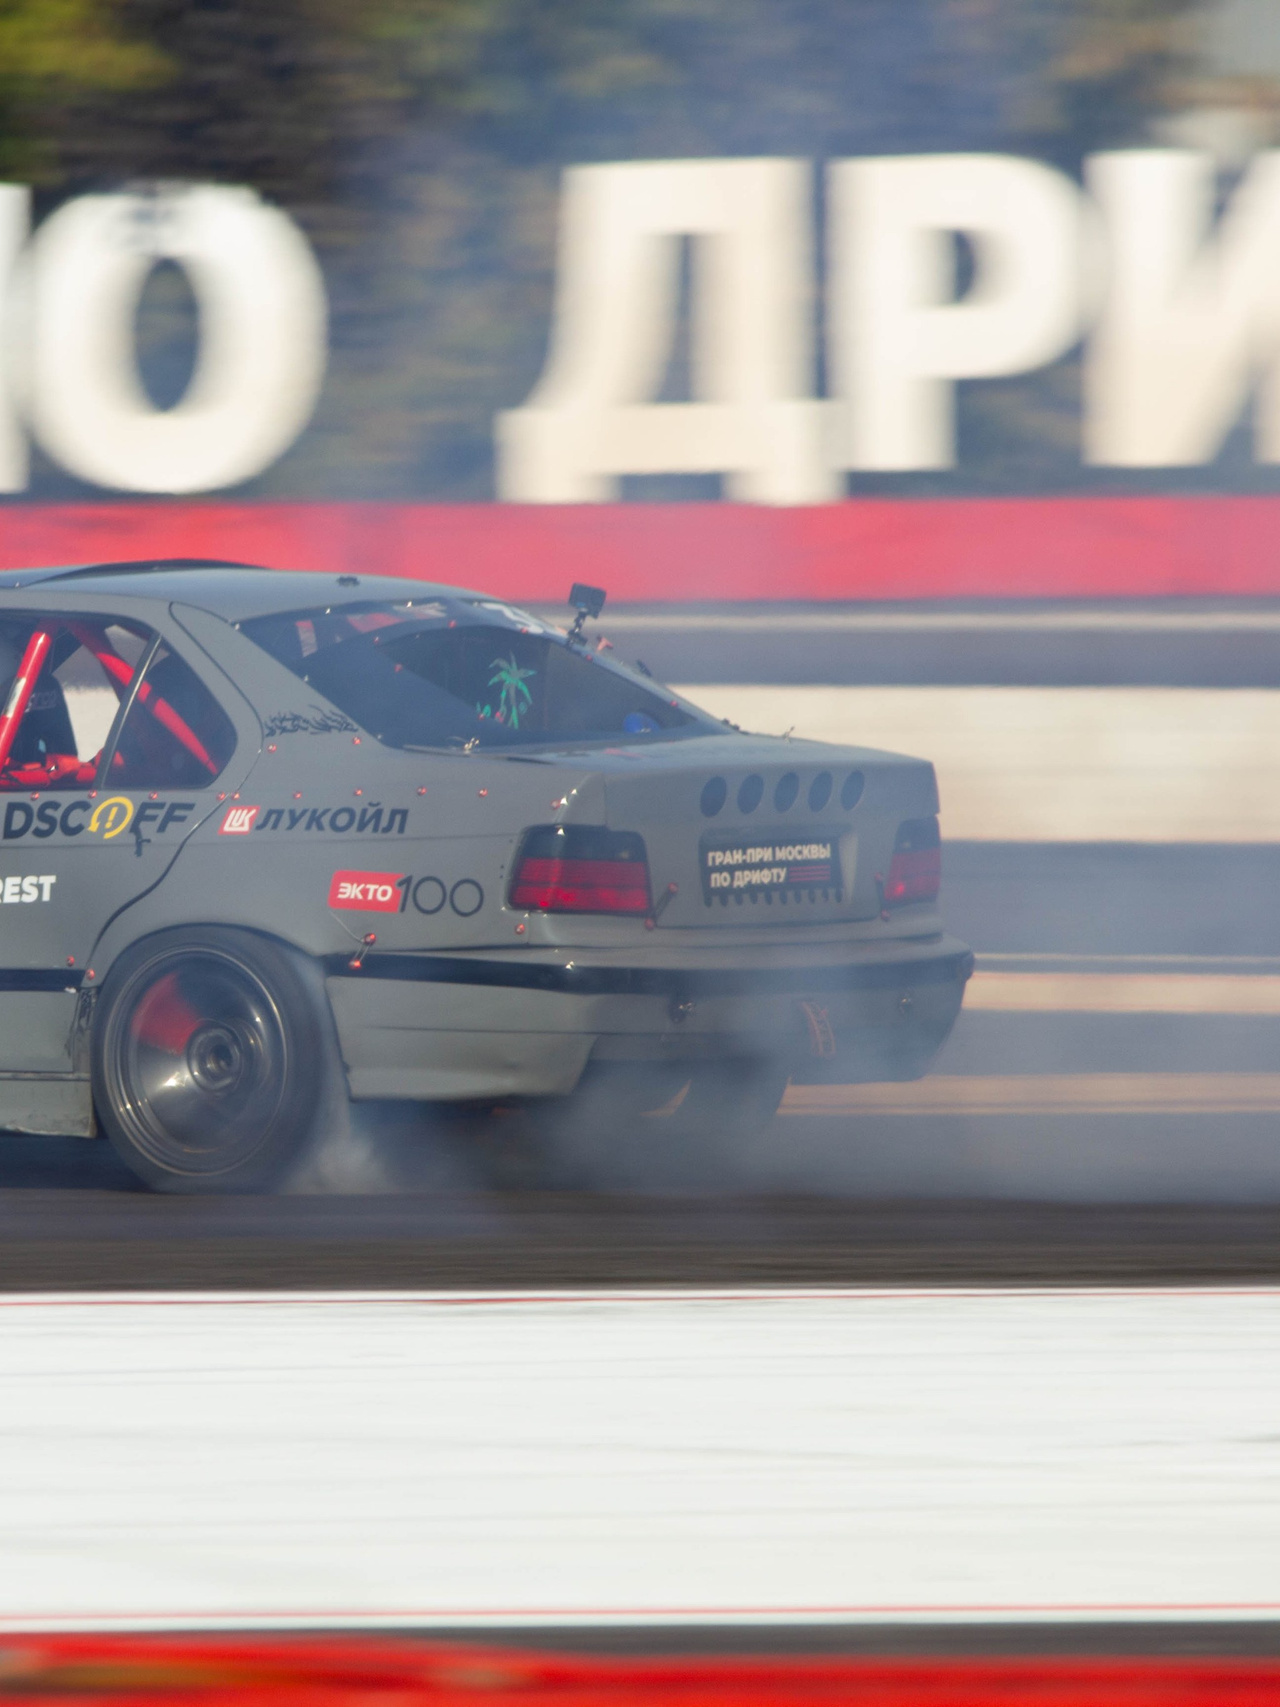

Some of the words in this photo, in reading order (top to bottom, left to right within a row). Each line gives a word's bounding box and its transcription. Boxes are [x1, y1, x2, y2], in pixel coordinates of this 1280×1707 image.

[255, 802, 409, 834] ЛУКОЙЛ
[707, 846, 773, 866] ГРАН-ПРИ
[775, 843, 831, 861] МОСКВЫ
[710, 871, 731, 888] ПО
[733, 867, 787, 889] ДРИФТУ
[336, 882, 393, 902] ЭКТО
[395, 874, 485, 917] 100
